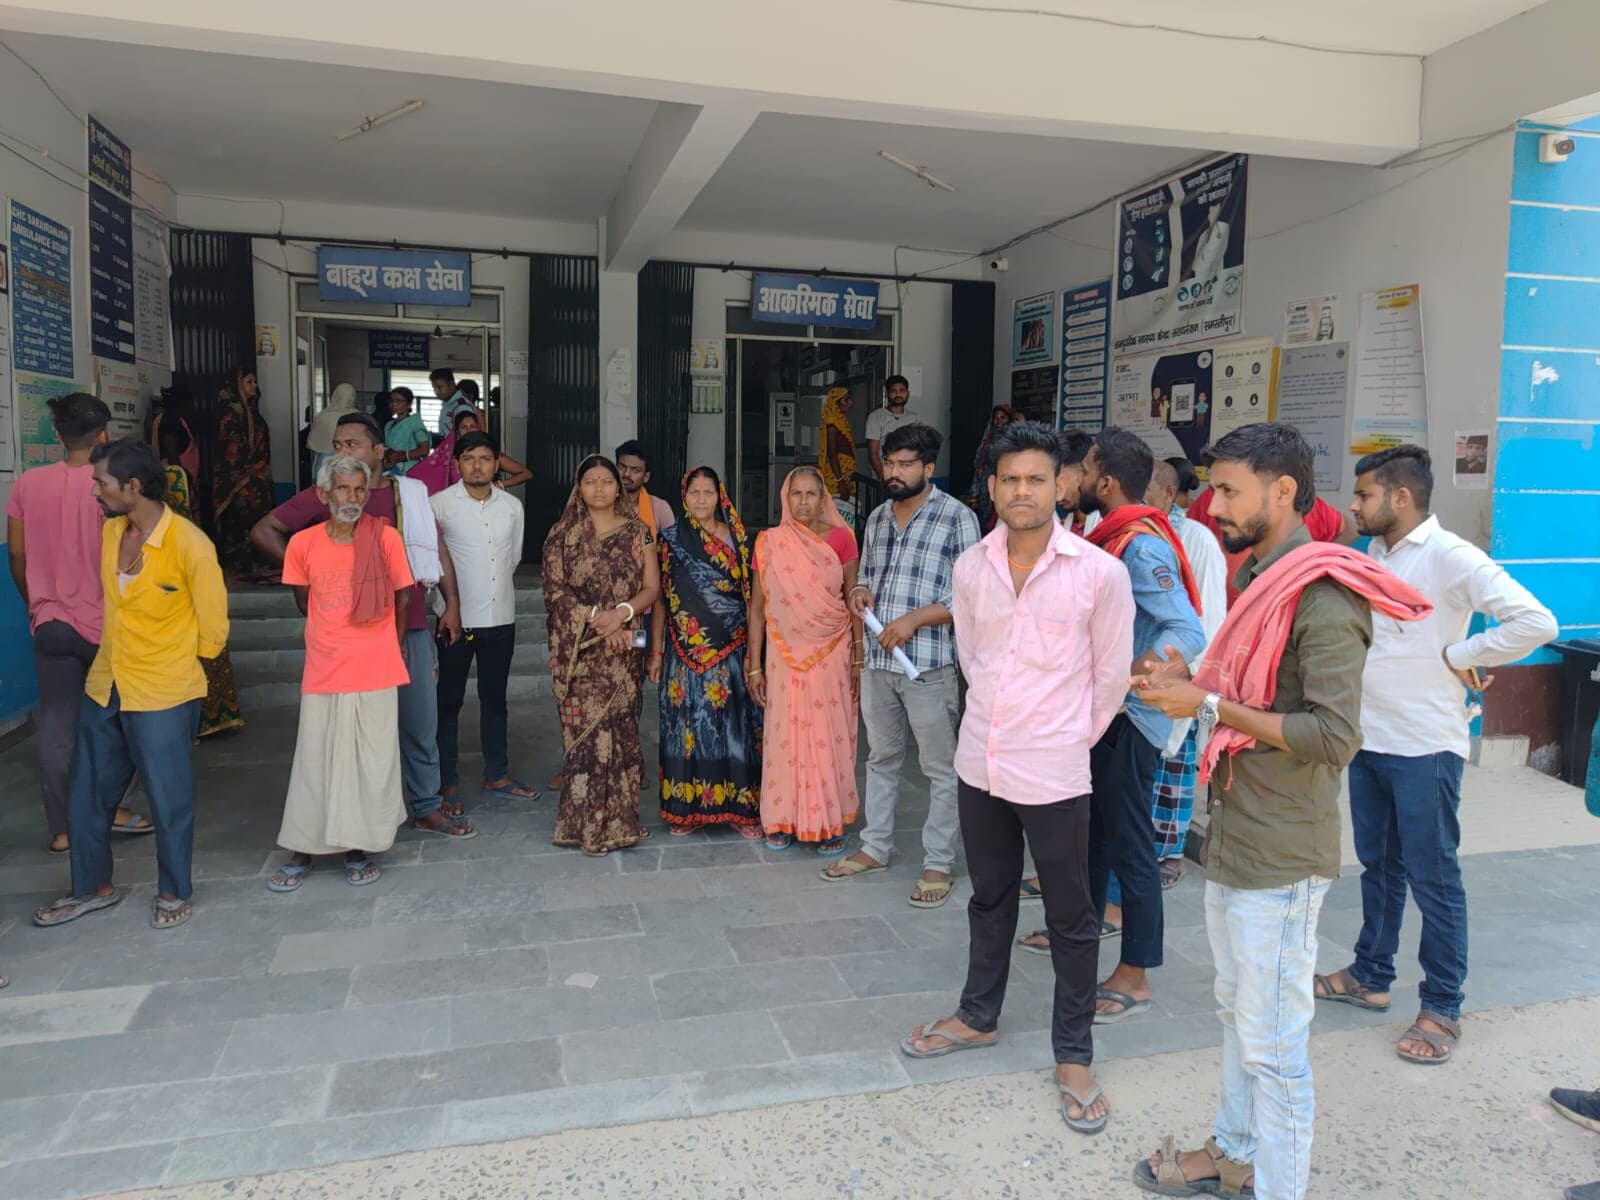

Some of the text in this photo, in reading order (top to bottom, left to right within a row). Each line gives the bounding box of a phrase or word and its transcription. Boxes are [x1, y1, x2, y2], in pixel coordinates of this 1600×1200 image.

[12, 221, 51, 248] AMBULANCE
[382, 266, 422, 290] कक्ष
[425, 259, 464, 292] सेवा
[758, 283, 876, 320] आकस्मिक सेवा
